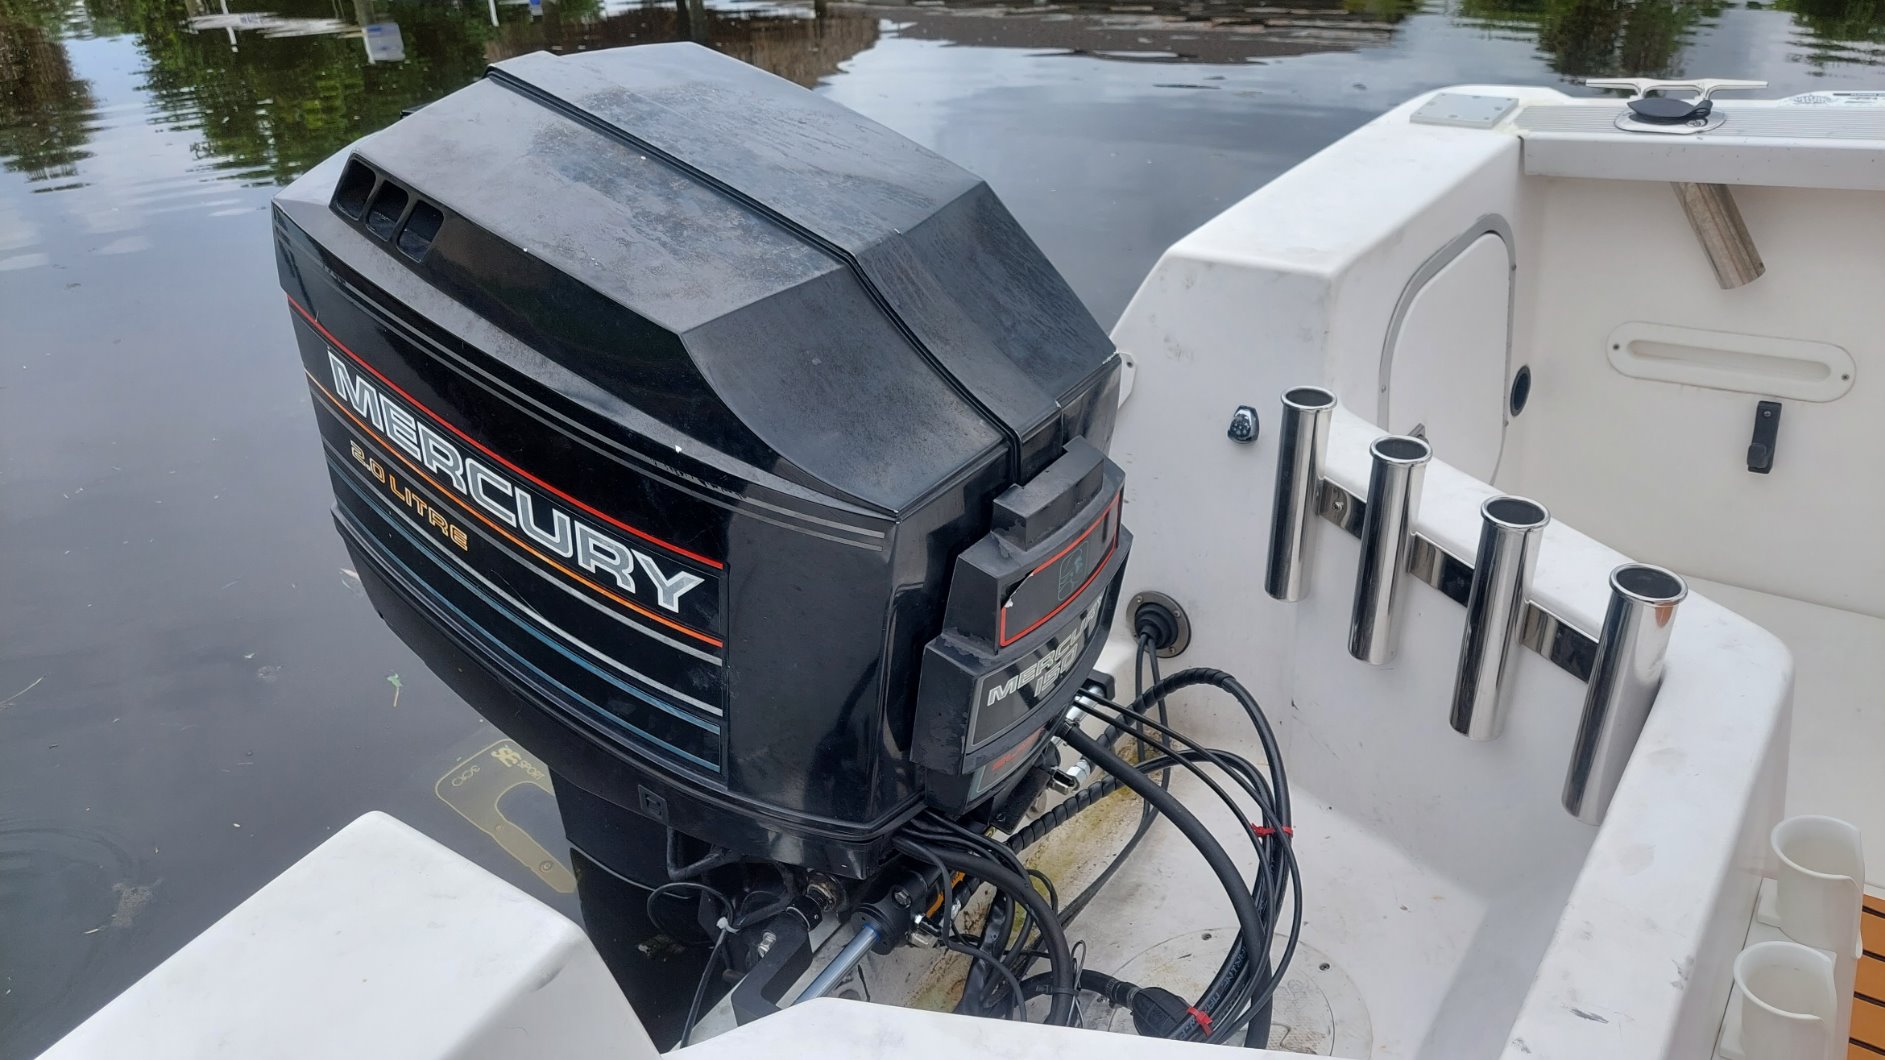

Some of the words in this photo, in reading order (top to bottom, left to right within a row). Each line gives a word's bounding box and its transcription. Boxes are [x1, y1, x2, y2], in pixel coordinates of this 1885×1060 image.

[328, 350, 705, 613] MERCURY
[350, 440, 386, 484] 2.0
[389, 474, 469, 551] LITRE
[1034, 643, 1078, 697] 150
